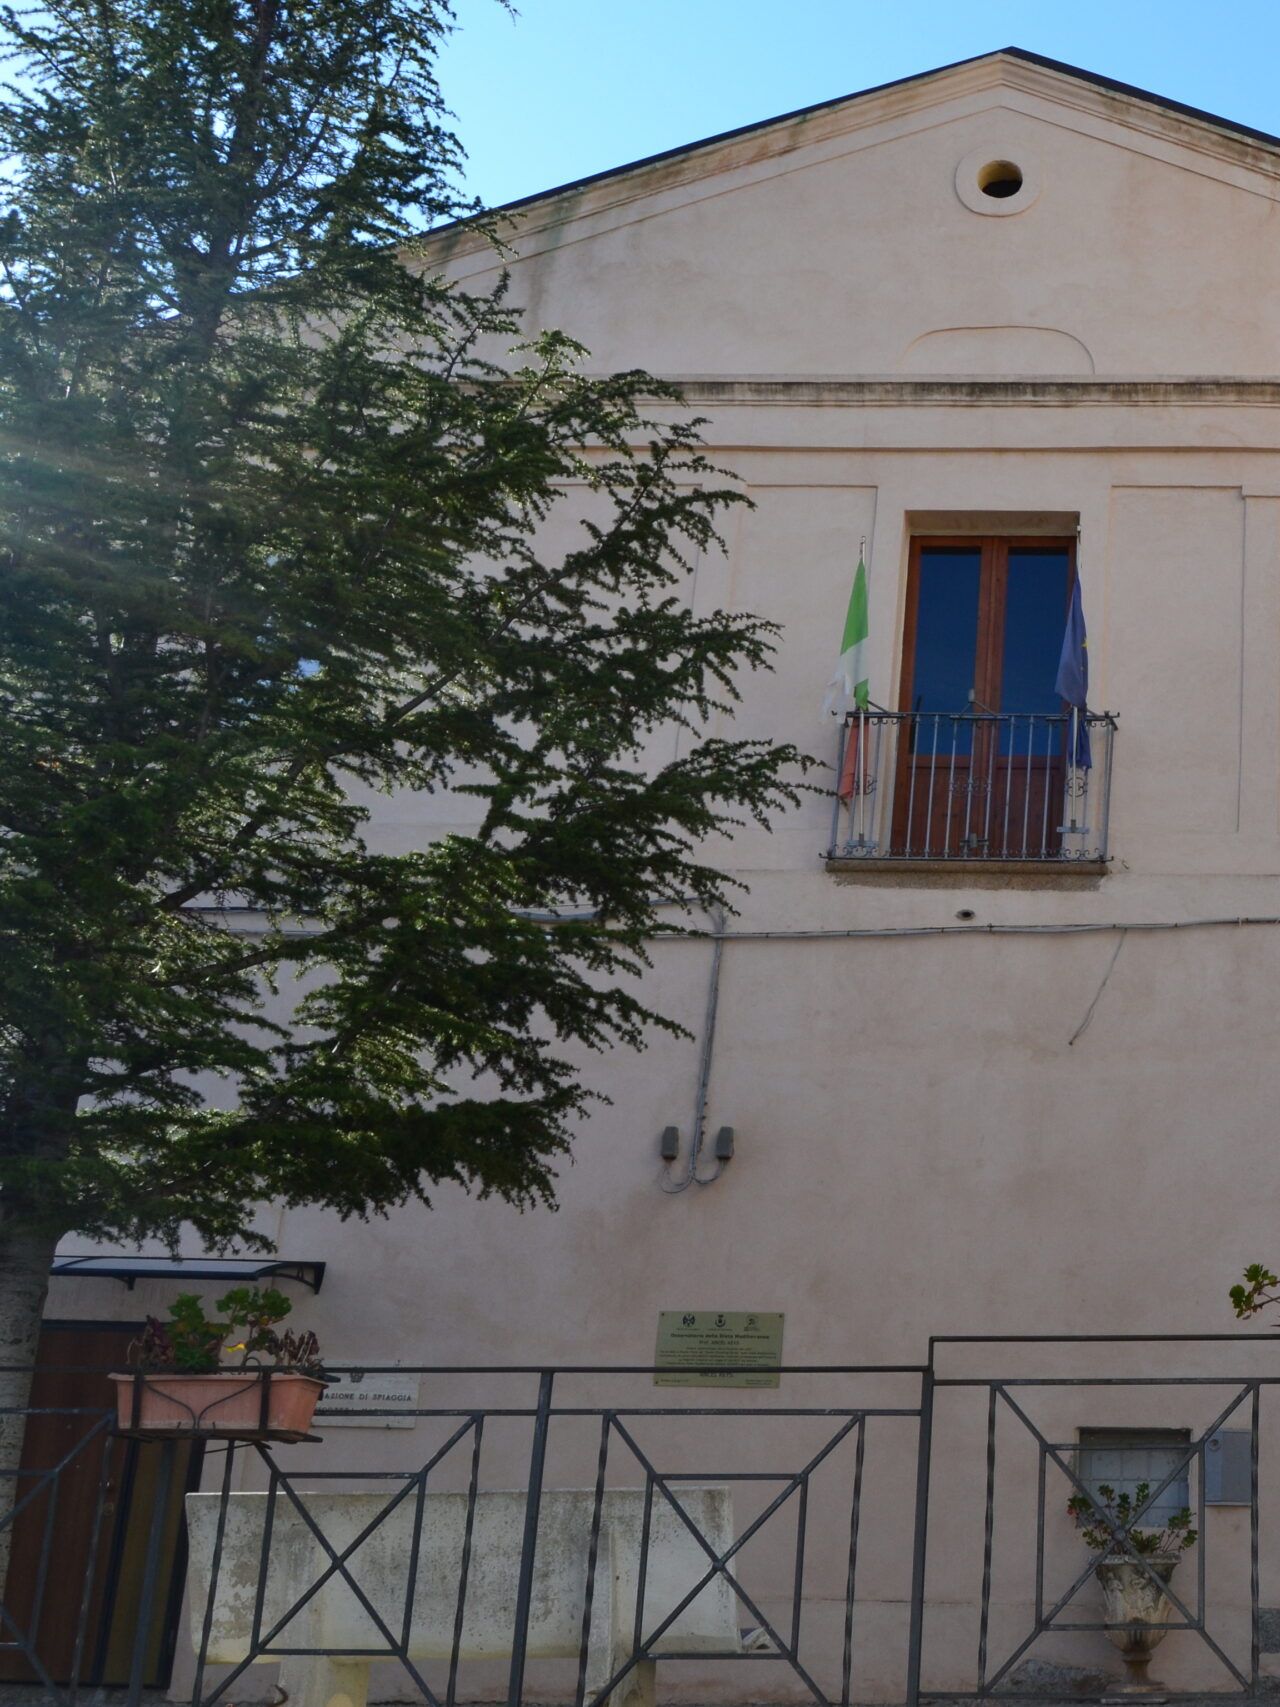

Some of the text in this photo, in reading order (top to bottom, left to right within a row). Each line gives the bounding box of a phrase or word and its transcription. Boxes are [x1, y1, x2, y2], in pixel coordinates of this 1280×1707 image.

[323, 1392, 412, 1402] AZIONE DI SPIAGGIA
